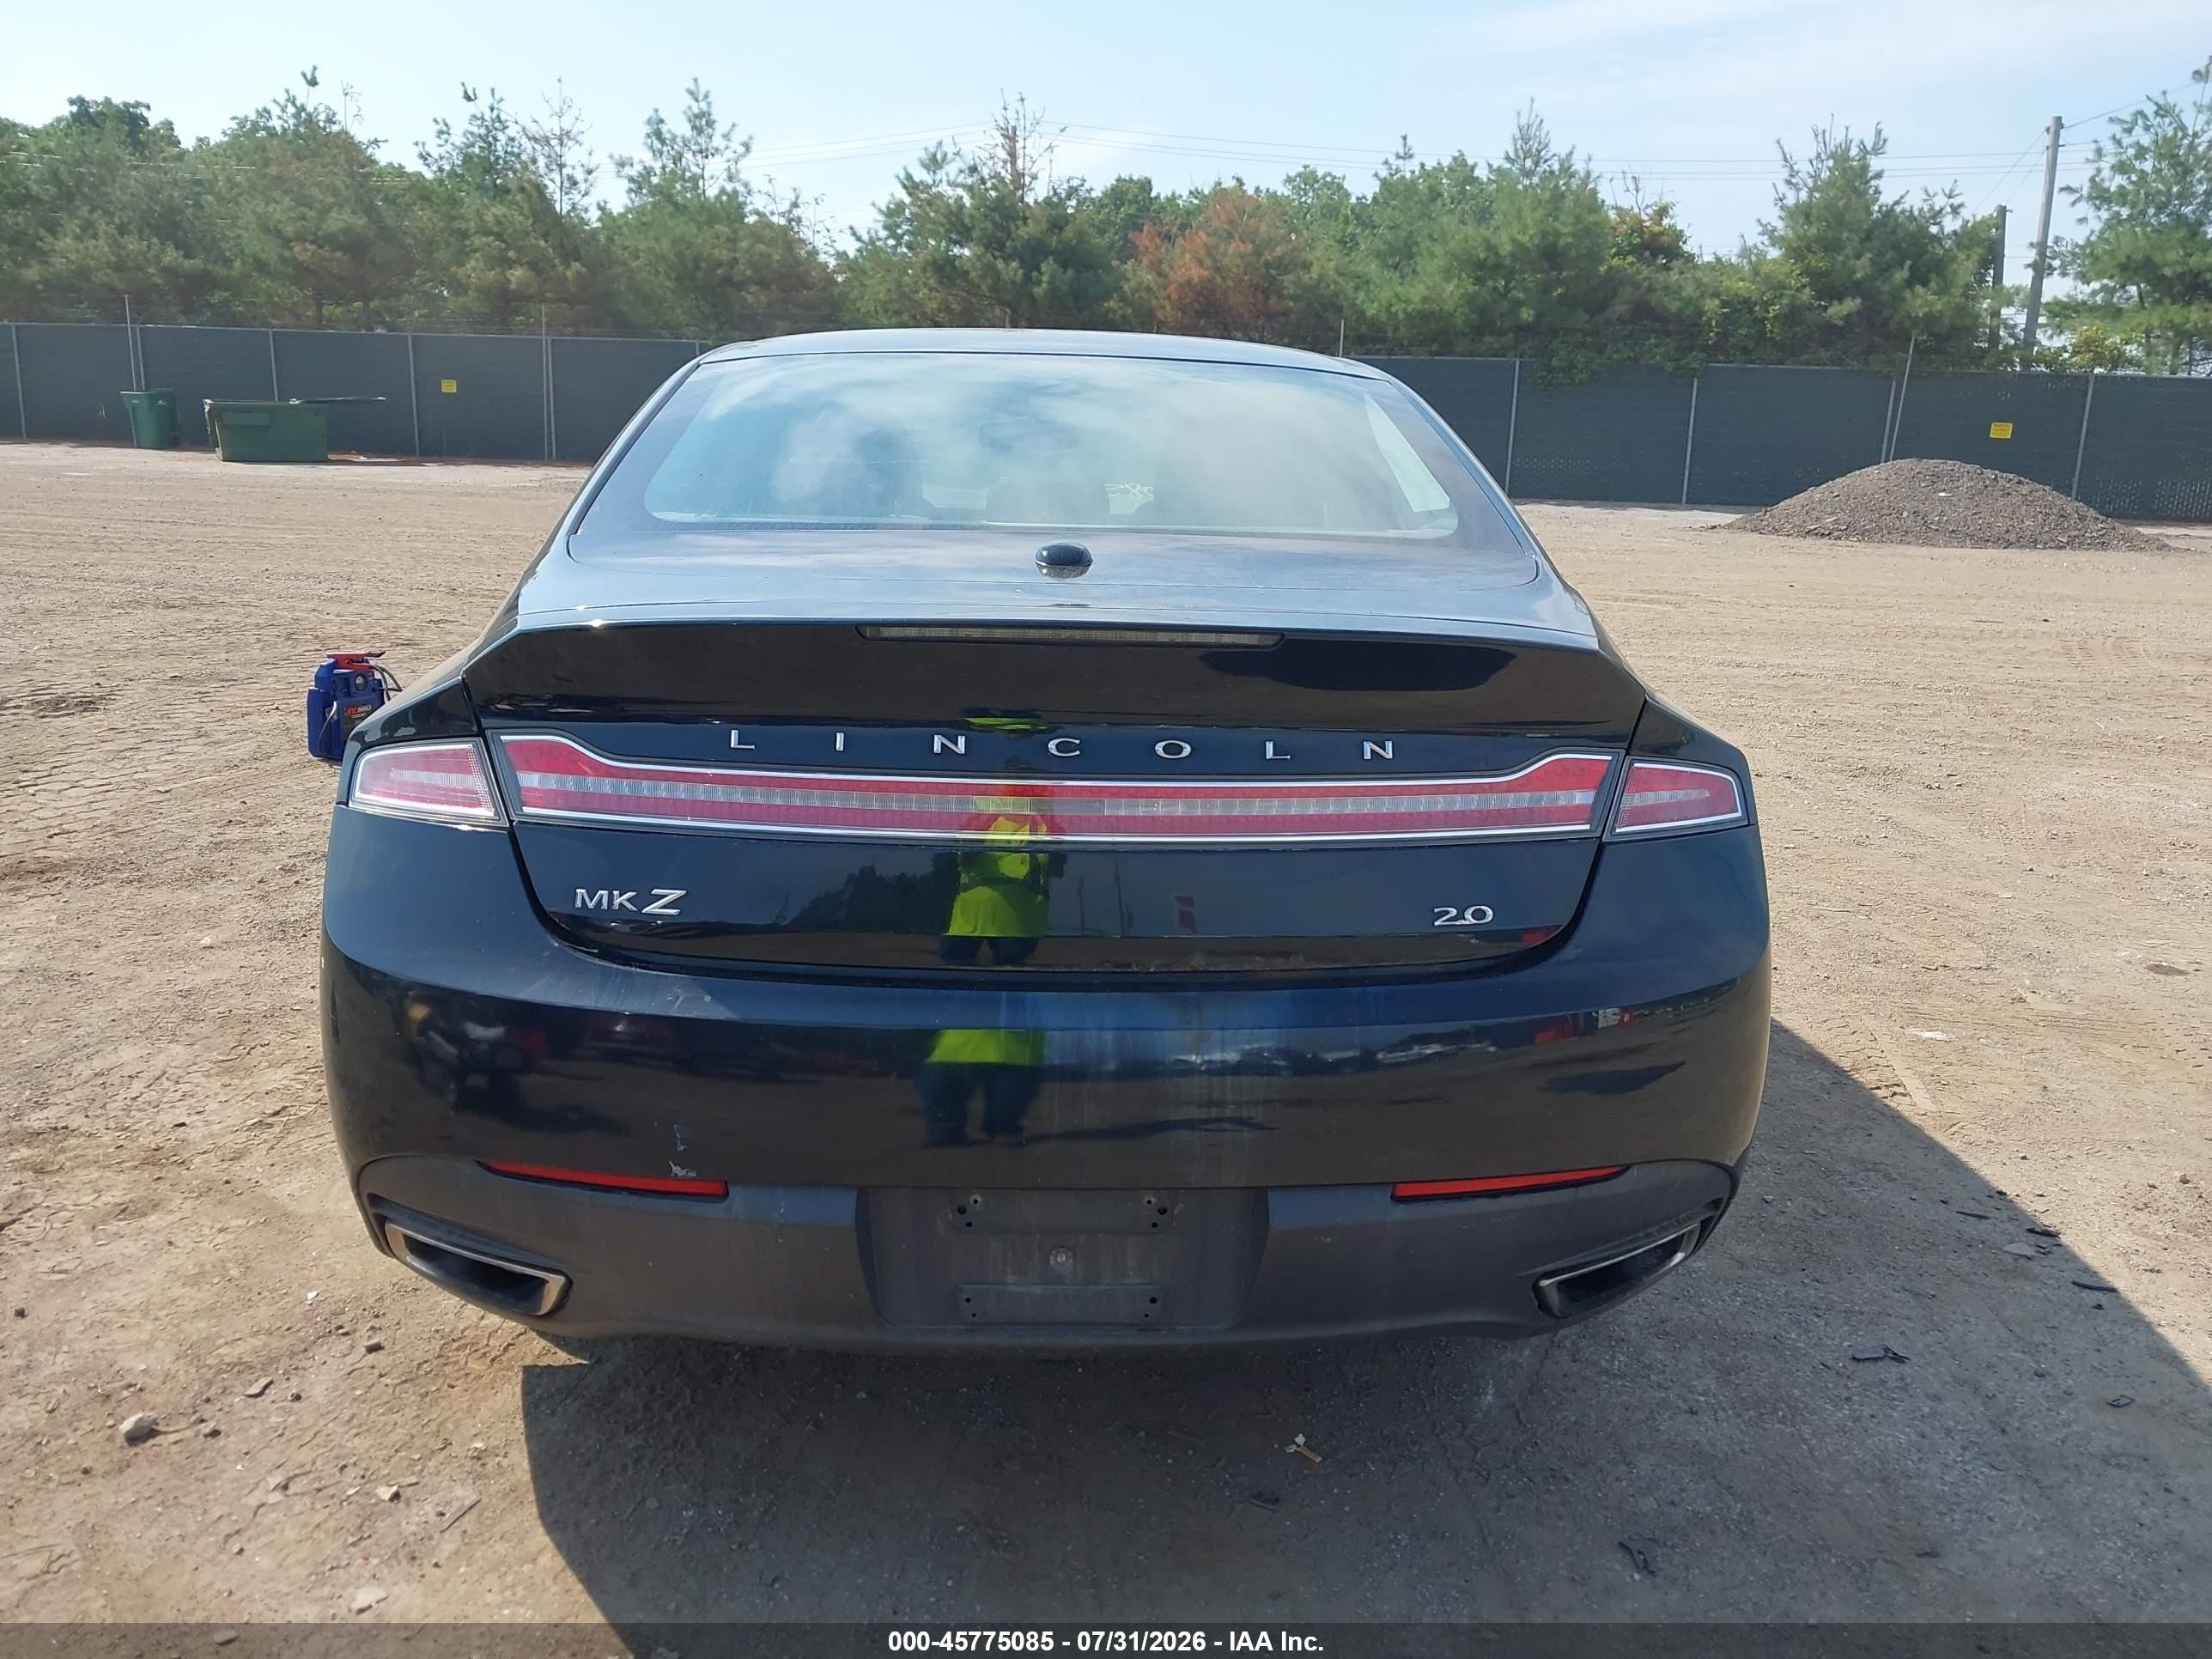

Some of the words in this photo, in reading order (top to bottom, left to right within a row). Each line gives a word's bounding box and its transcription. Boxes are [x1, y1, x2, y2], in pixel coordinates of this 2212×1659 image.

[730, 729, 1394, 761] LINCOLN
[574, 888, 688, 915] MKZ
[1433, 905, 1494, 927] 2.0
